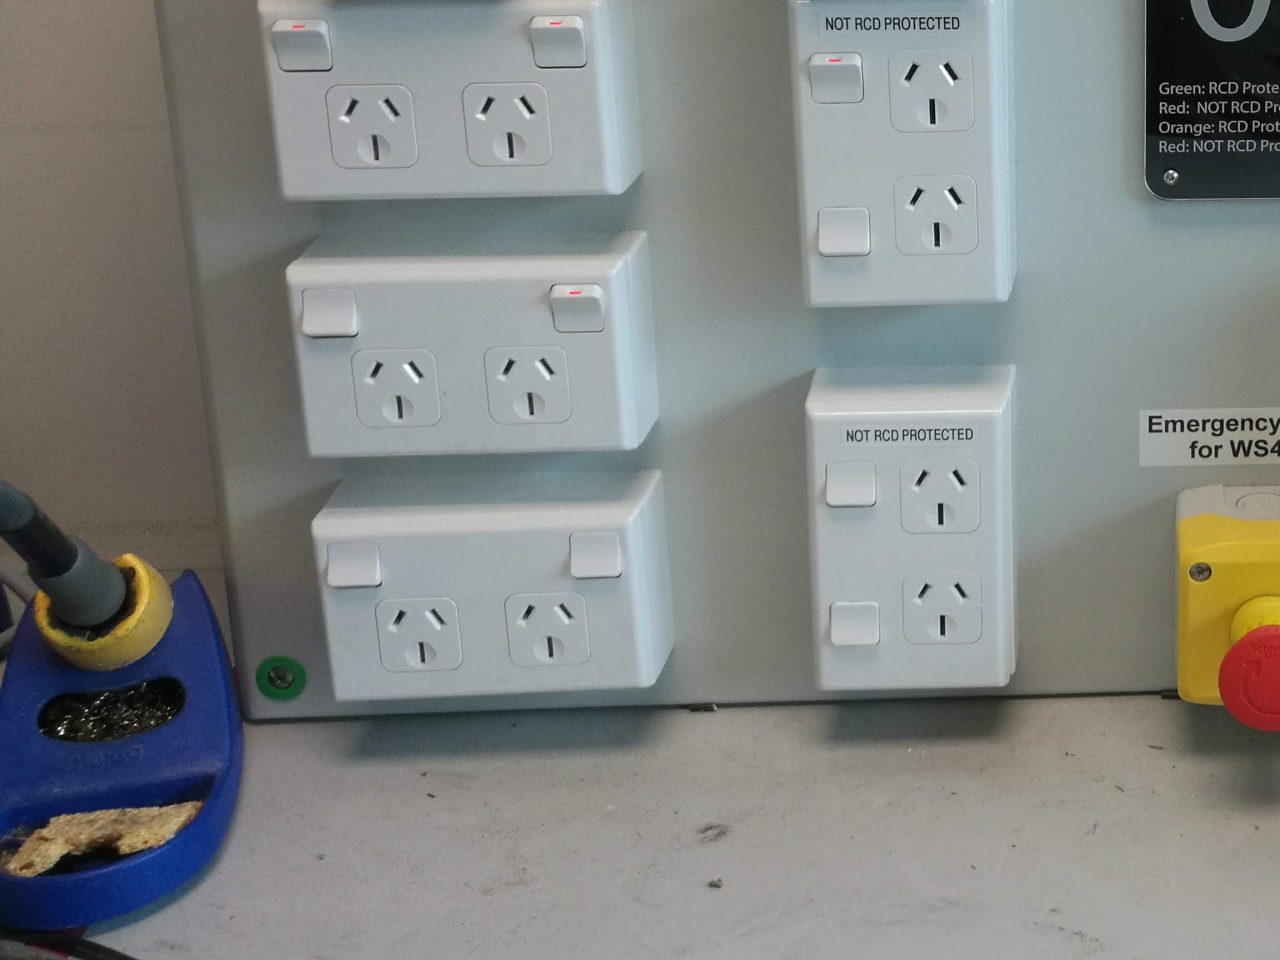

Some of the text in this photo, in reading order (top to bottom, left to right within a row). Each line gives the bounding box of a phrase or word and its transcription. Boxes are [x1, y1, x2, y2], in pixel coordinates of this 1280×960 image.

[825, 16, 960, 31] NOT RCD PROTECTED
[1158, 82, 1205, 95] Green:
[1208, 81, 1239, 94] RCD
[1159, 101, 1190, 114] Red:
[1197, 101, 1228, 114] NOT
[1231, 101, 1261, 113] RCD
[1158, 121, 1215, 136] Orange:
[1218, 120, 1248, 133] RCD
[1159, 140, 1189, 153] Red:
[1193, 140, 1224, 152] NOT
[1227, 140, 1257, 152] RCD
[846, 428, 973, 442] NOT RCD PROTECTED
[1189, 440, 1222, 458] for
